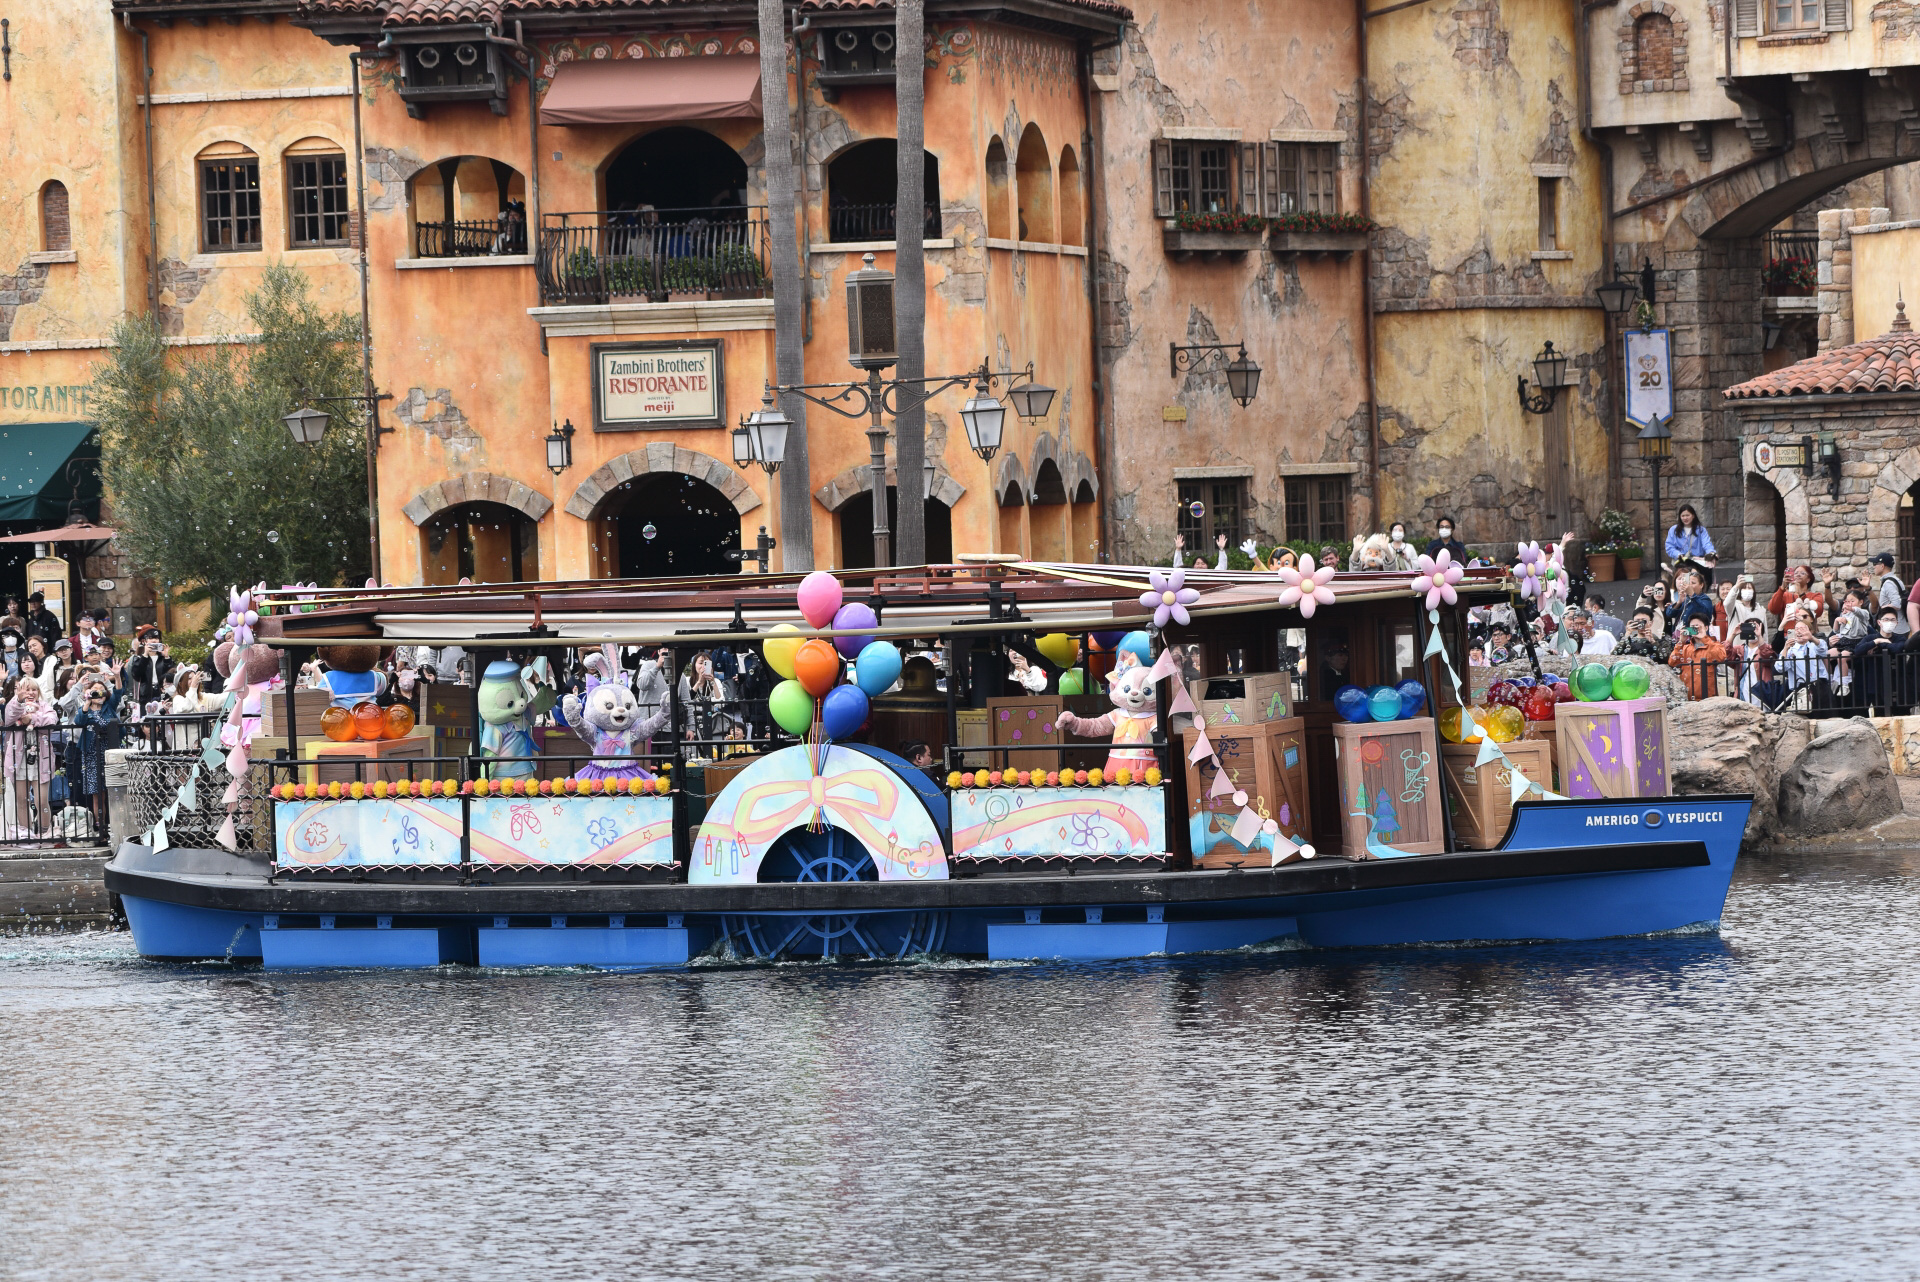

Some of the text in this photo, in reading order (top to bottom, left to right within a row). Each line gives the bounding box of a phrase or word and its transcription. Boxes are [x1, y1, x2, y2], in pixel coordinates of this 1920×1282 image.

[610, 357, 707, 375] Zambini Brothers'
[609, 375, 708, 394] RISTORANTE
[1639, 371, 1661, 387] 20
[644, 401, 674, 413] meiji
[1585, 811, 1723, 827] AMERIGO VESPUCCI
